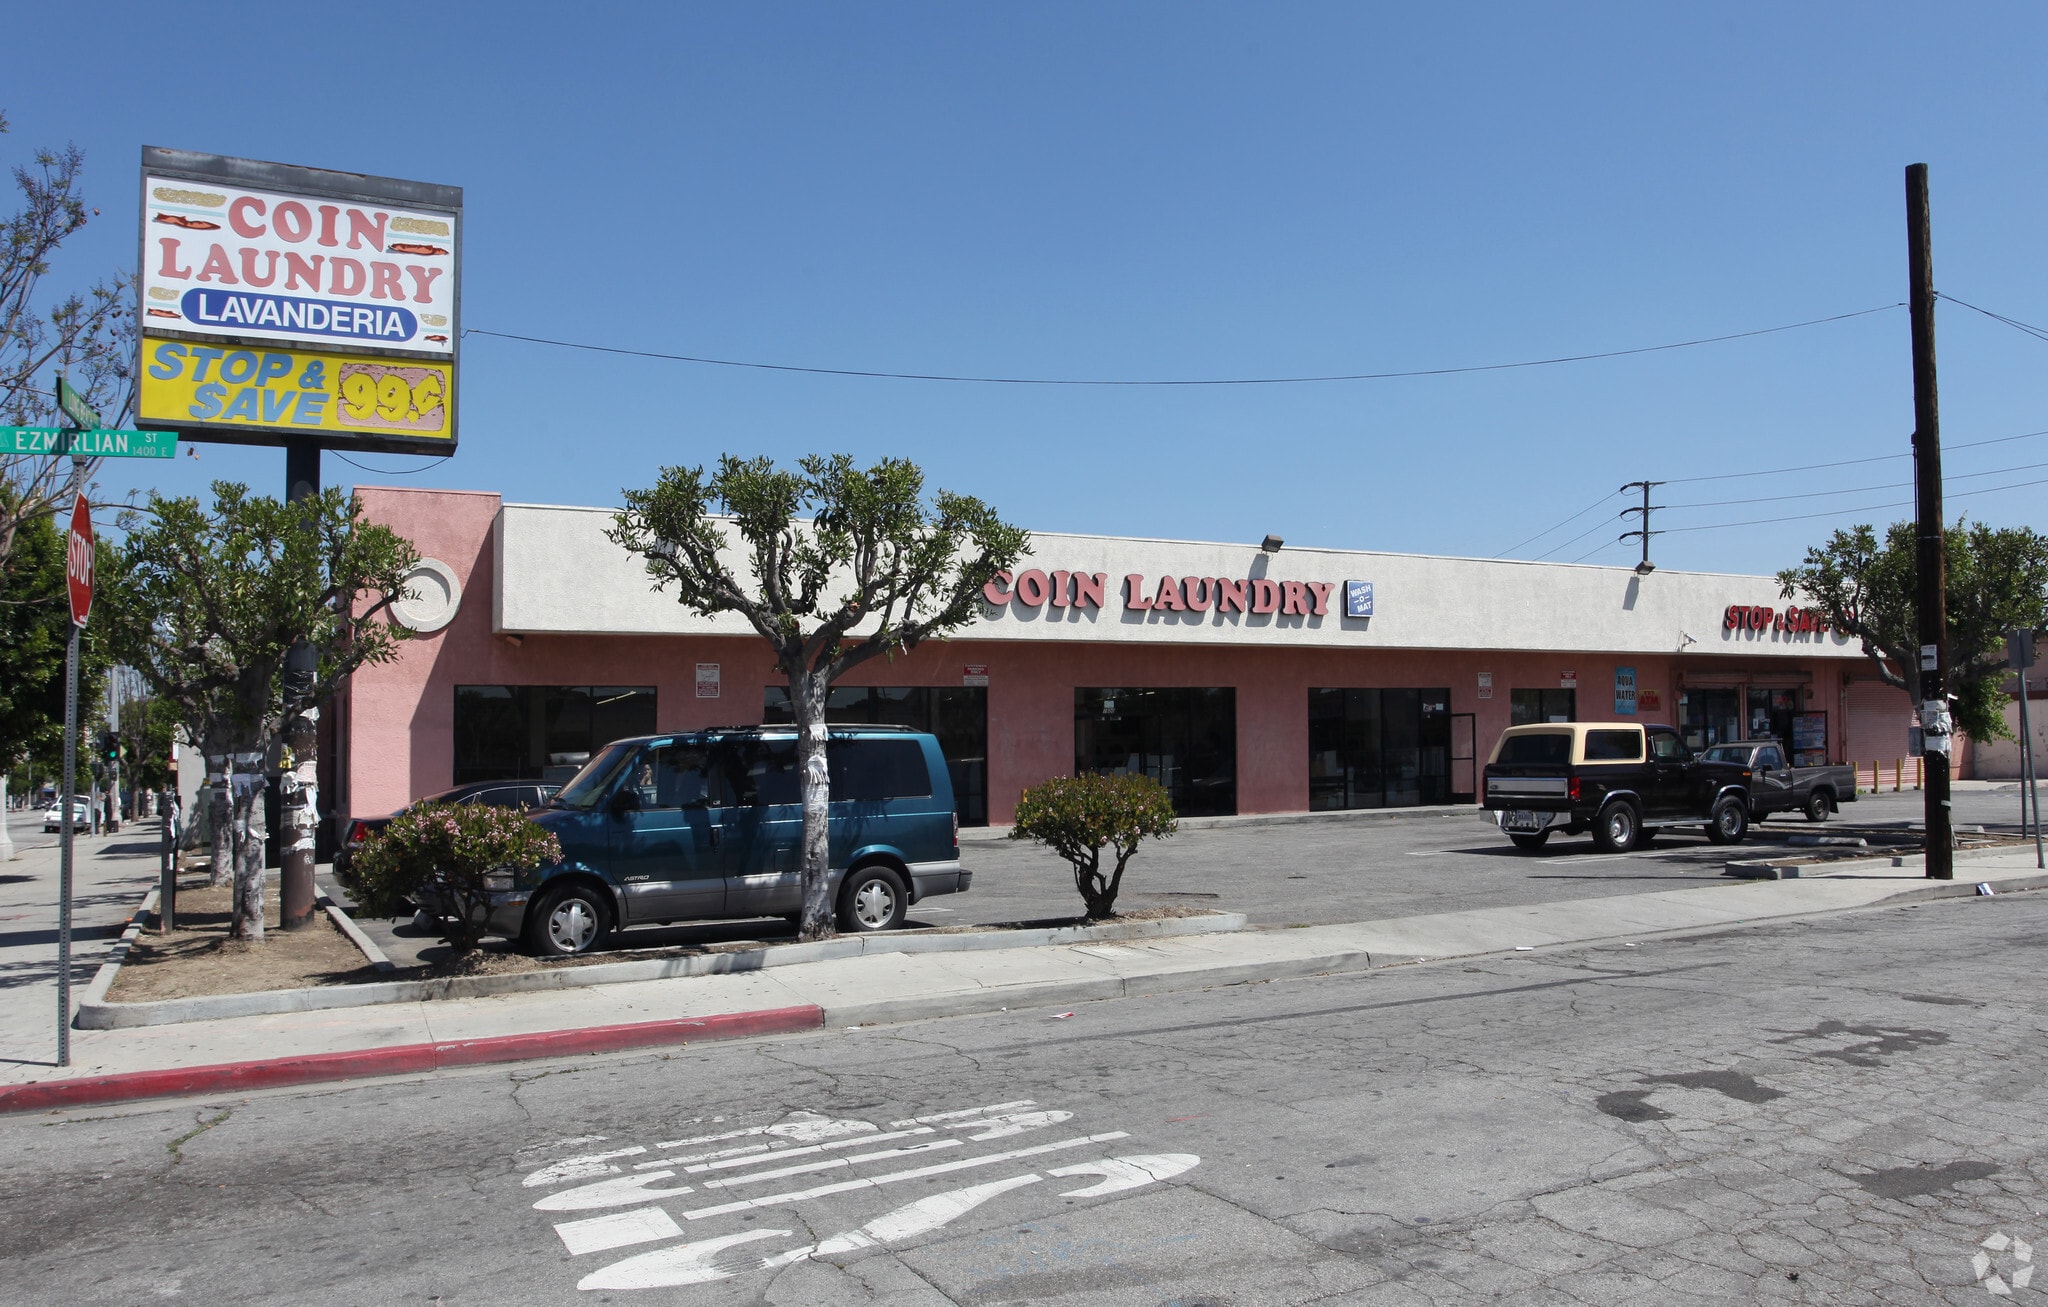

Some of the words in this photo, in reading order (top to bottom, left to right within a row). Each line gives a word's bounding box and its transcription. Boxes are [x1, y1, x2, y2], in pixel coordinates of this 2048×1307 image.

[228, 196, 389, 252] COIN
[158, 237, 443, 304] LAUNDRY
[199, 293, 405, 337] LAVANDERIA
[148, 342, 294, 387] STOP
[298, 359, 327, 389] &
[15, 431, 129, 453] EZMIRLIAN
[145, 433, 158, 443] ST
[132, 446, 157, 457] 1400
[162, 447, 168, 457] E
[69, 529, 93, 587] STOP
[983, 568, 1108, 609] COIN
[1126, 574, 1336, 616] LAUNDRY
[1350, 585, 1371, 597] WASH
[1357, 601, 1371, 613] MAT
[1724, 604, 1774, 631] STOP
[1778, 612, 1785, 631] &
[1617, 675, 1634, 686] AQUA
[1615, 690, 1636, 701] WATER
[1640, 696, 1659, 705] ATM
